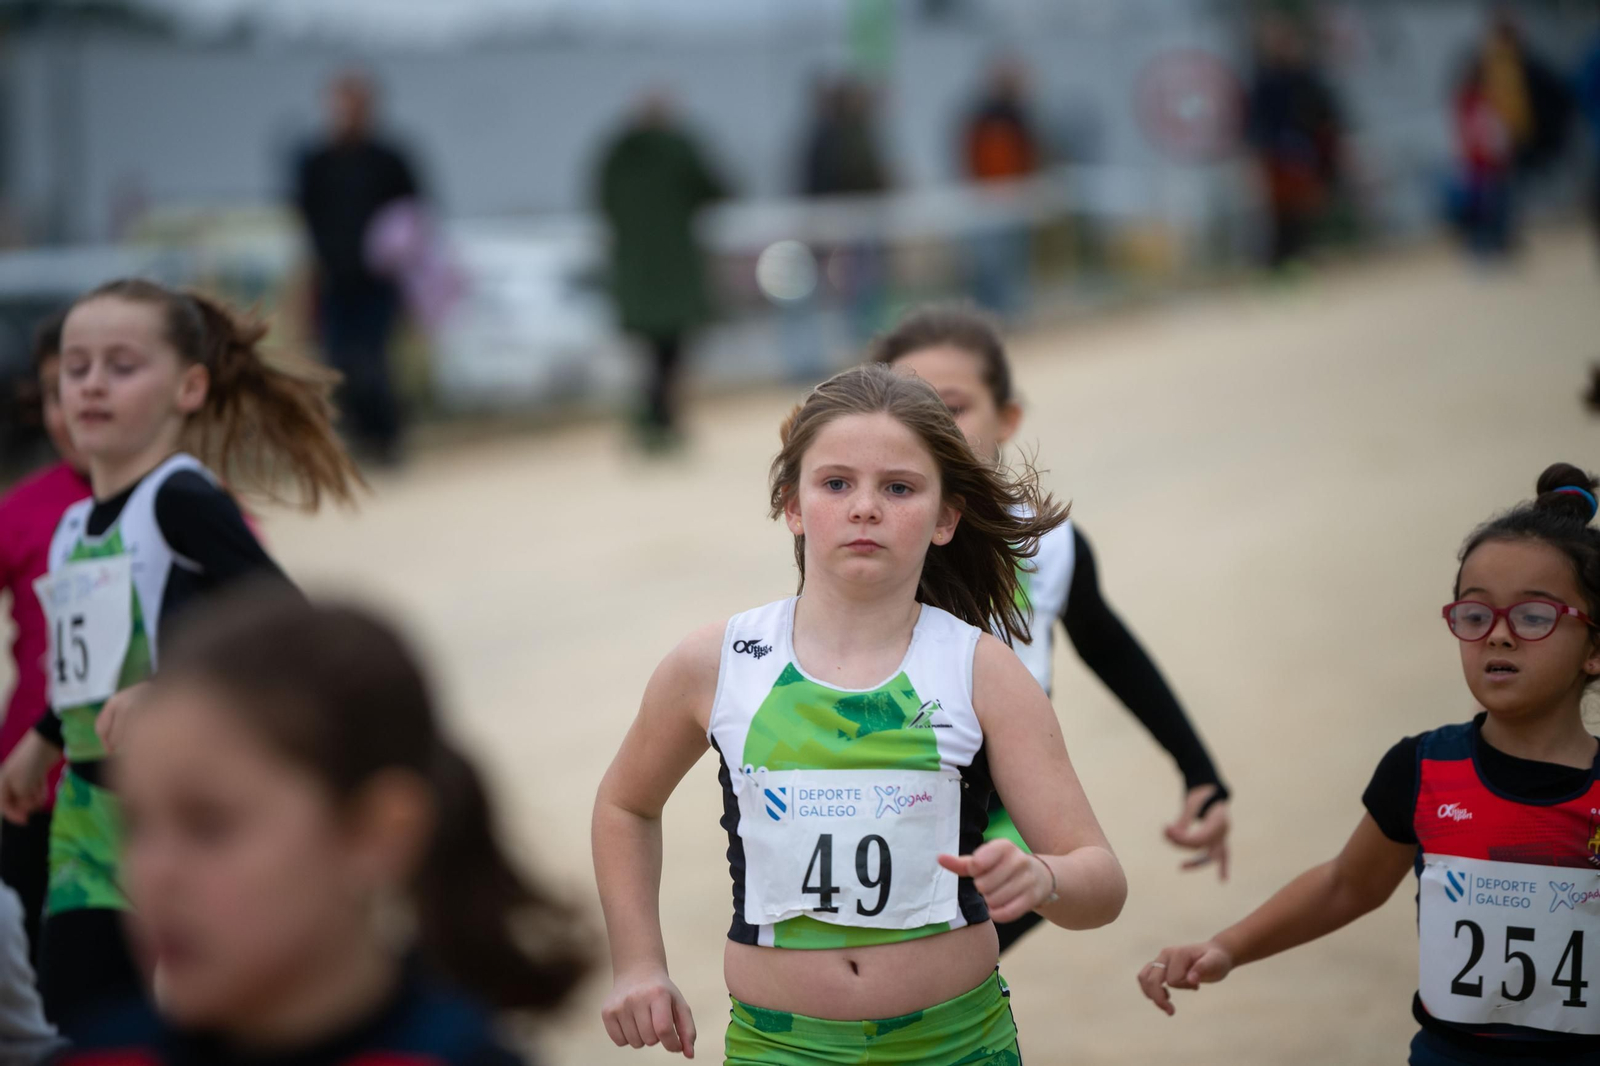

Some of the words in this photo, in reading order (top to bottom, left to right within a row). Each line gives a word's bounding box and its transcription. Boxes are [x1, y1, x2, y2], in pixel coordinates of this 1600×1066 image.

[799, 788, 862, 801] DEPORTE
[799, 804, 857, 817] GALEGO
[801, 833, 893, 917] 49
[1476, 877, 1537, 894] DEPORTE
[1476, 893, 1531, 909] GALEGO
[1450, 919, 1589, 1008] 254
